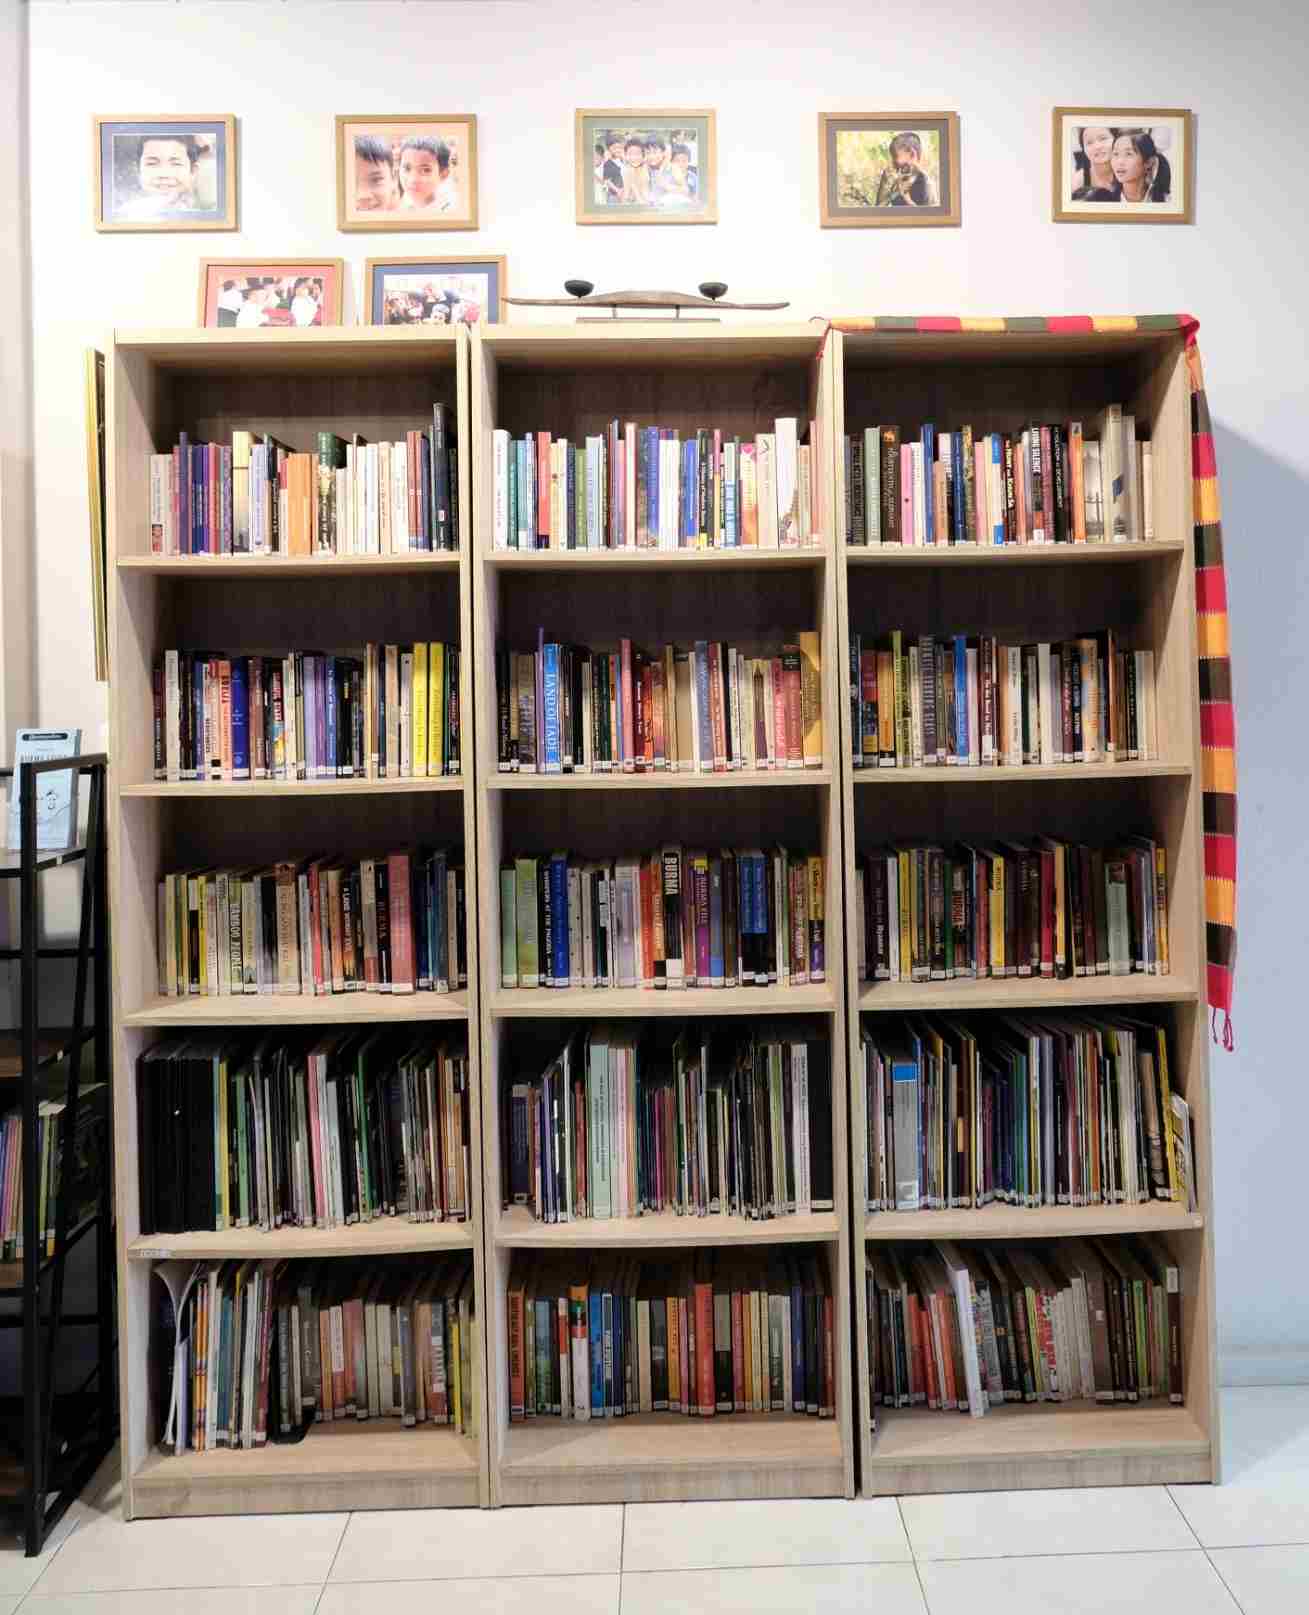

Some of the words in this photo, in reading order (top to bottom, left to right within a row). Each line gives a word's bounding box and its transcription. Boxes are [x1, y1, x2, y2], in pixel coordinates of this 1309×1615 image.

[1032, 428, 1041, 448] LIVING
[1032, 448, 1041, 473] SILENCE
[545, 673, 557, 706] LAND
[546, 708, 557, 721] OF
[664, 858, 678, 896] BURMA
[231, 903, 241, 938] BAMBOO
[231, 941, 241, 971] PEOPLE
